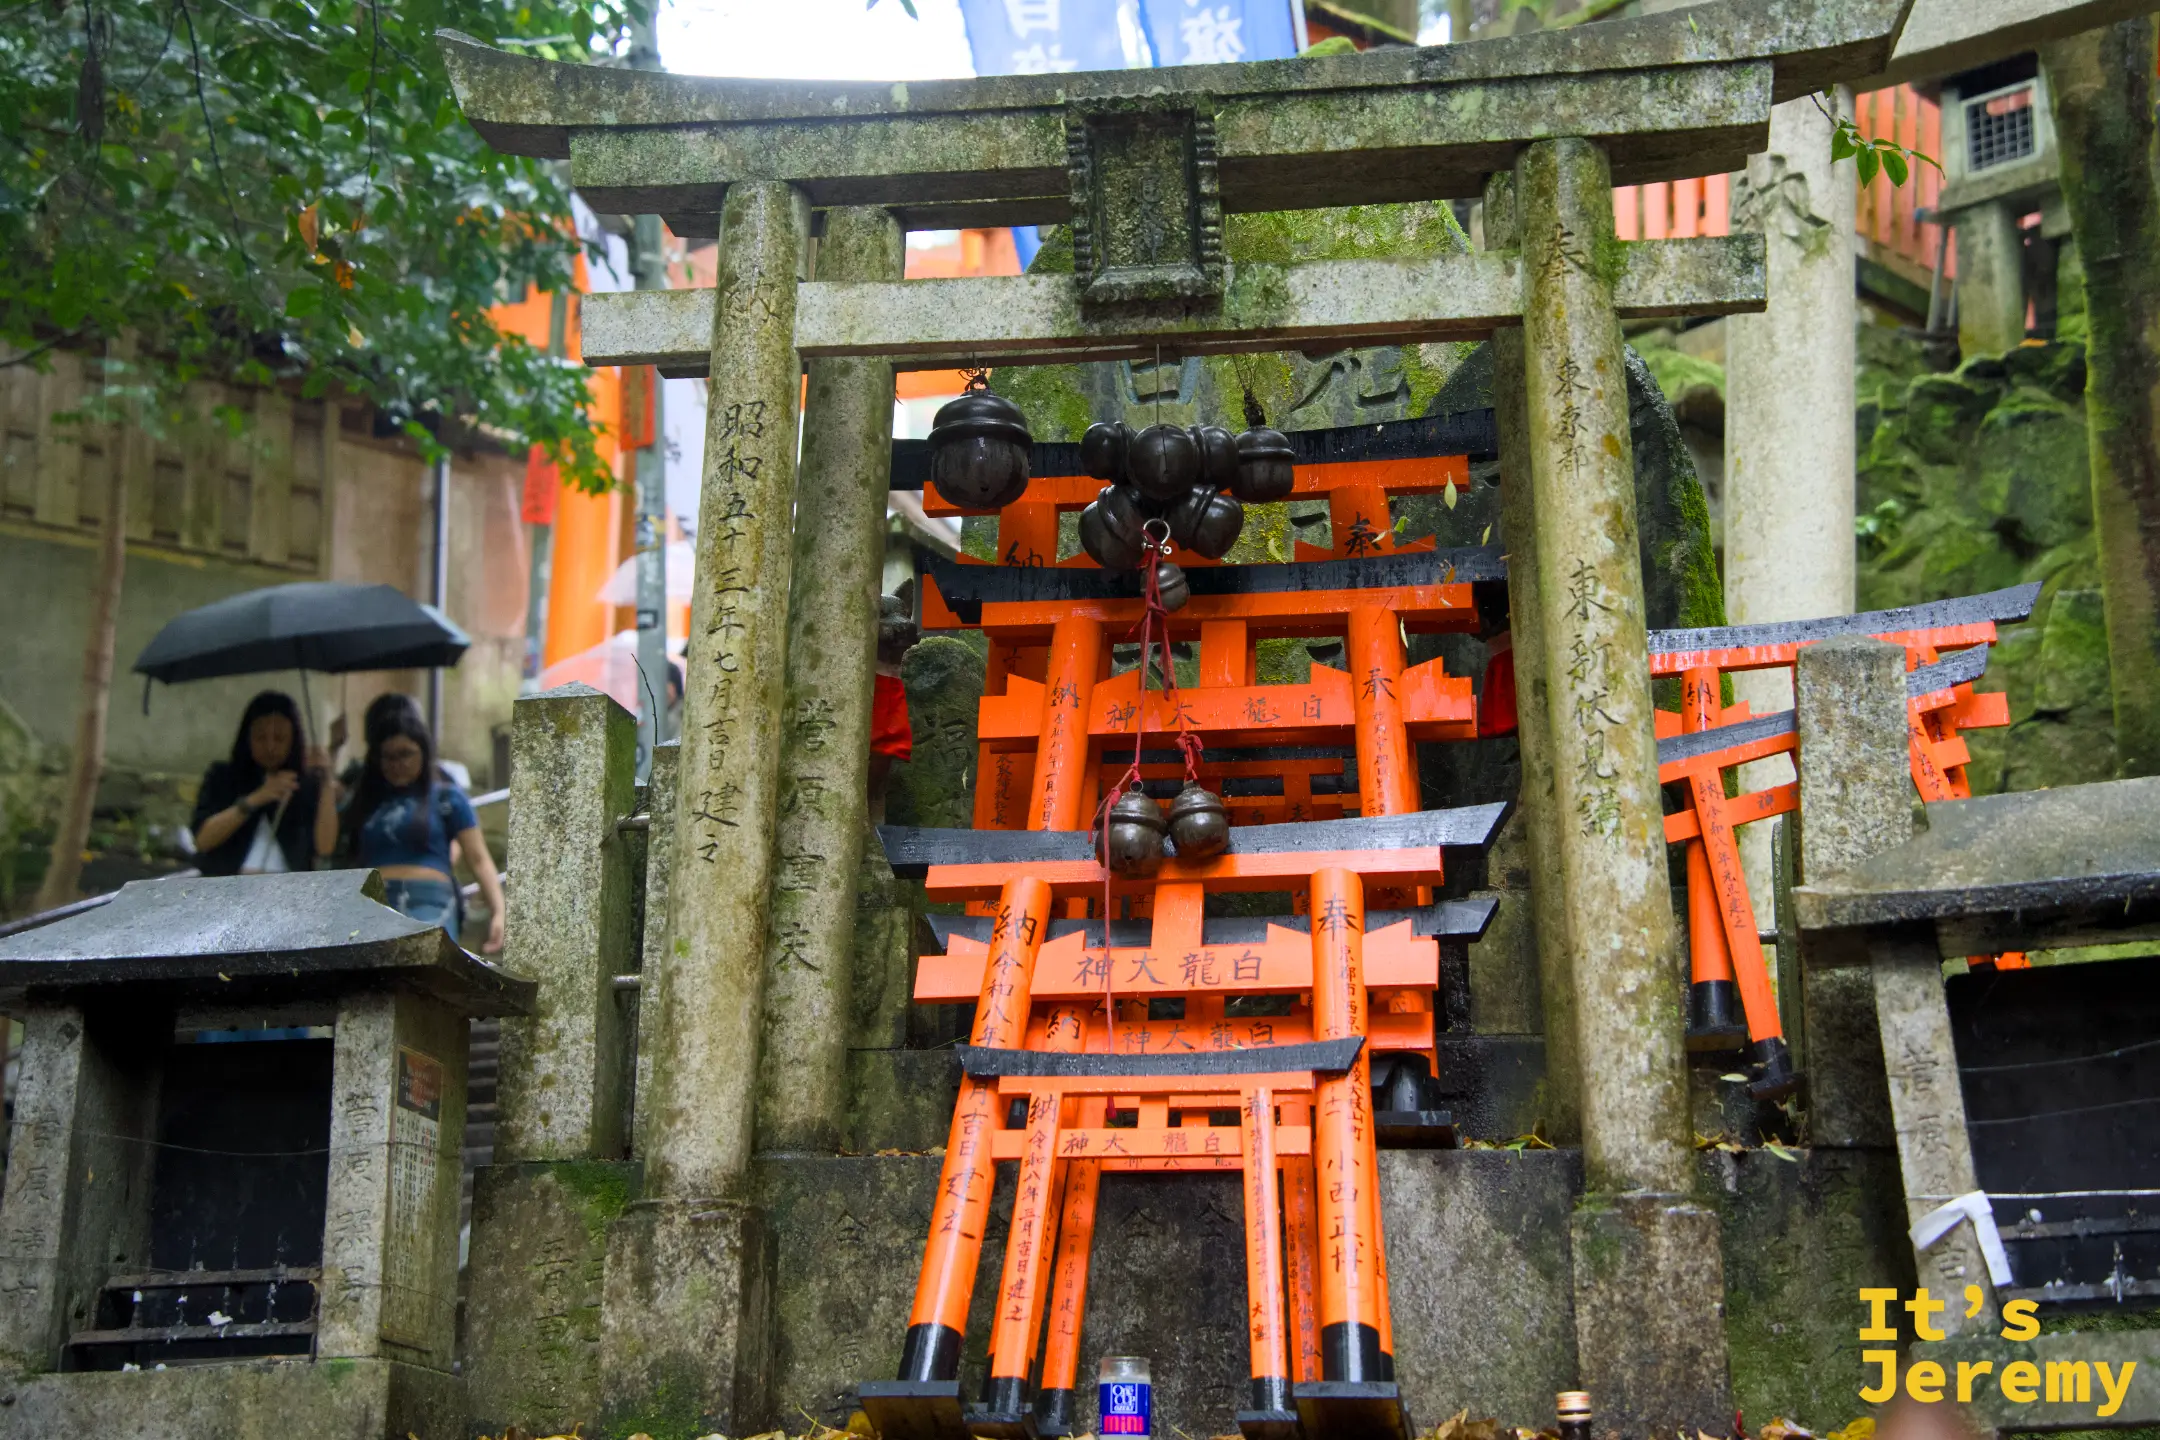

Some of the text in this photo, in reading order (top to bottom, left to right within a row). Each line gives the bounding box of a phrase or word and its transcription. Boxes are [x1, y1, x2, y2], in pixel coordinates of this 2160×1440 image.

[1553, 356, 1590, 479] 東京都
[1344, 511, 1382, 558] 奉
[1361, 667, 1397, 700] 奉
[1316, 893, 1360, 941] 奉
[1104, 1415, 1143, 1433] mini
